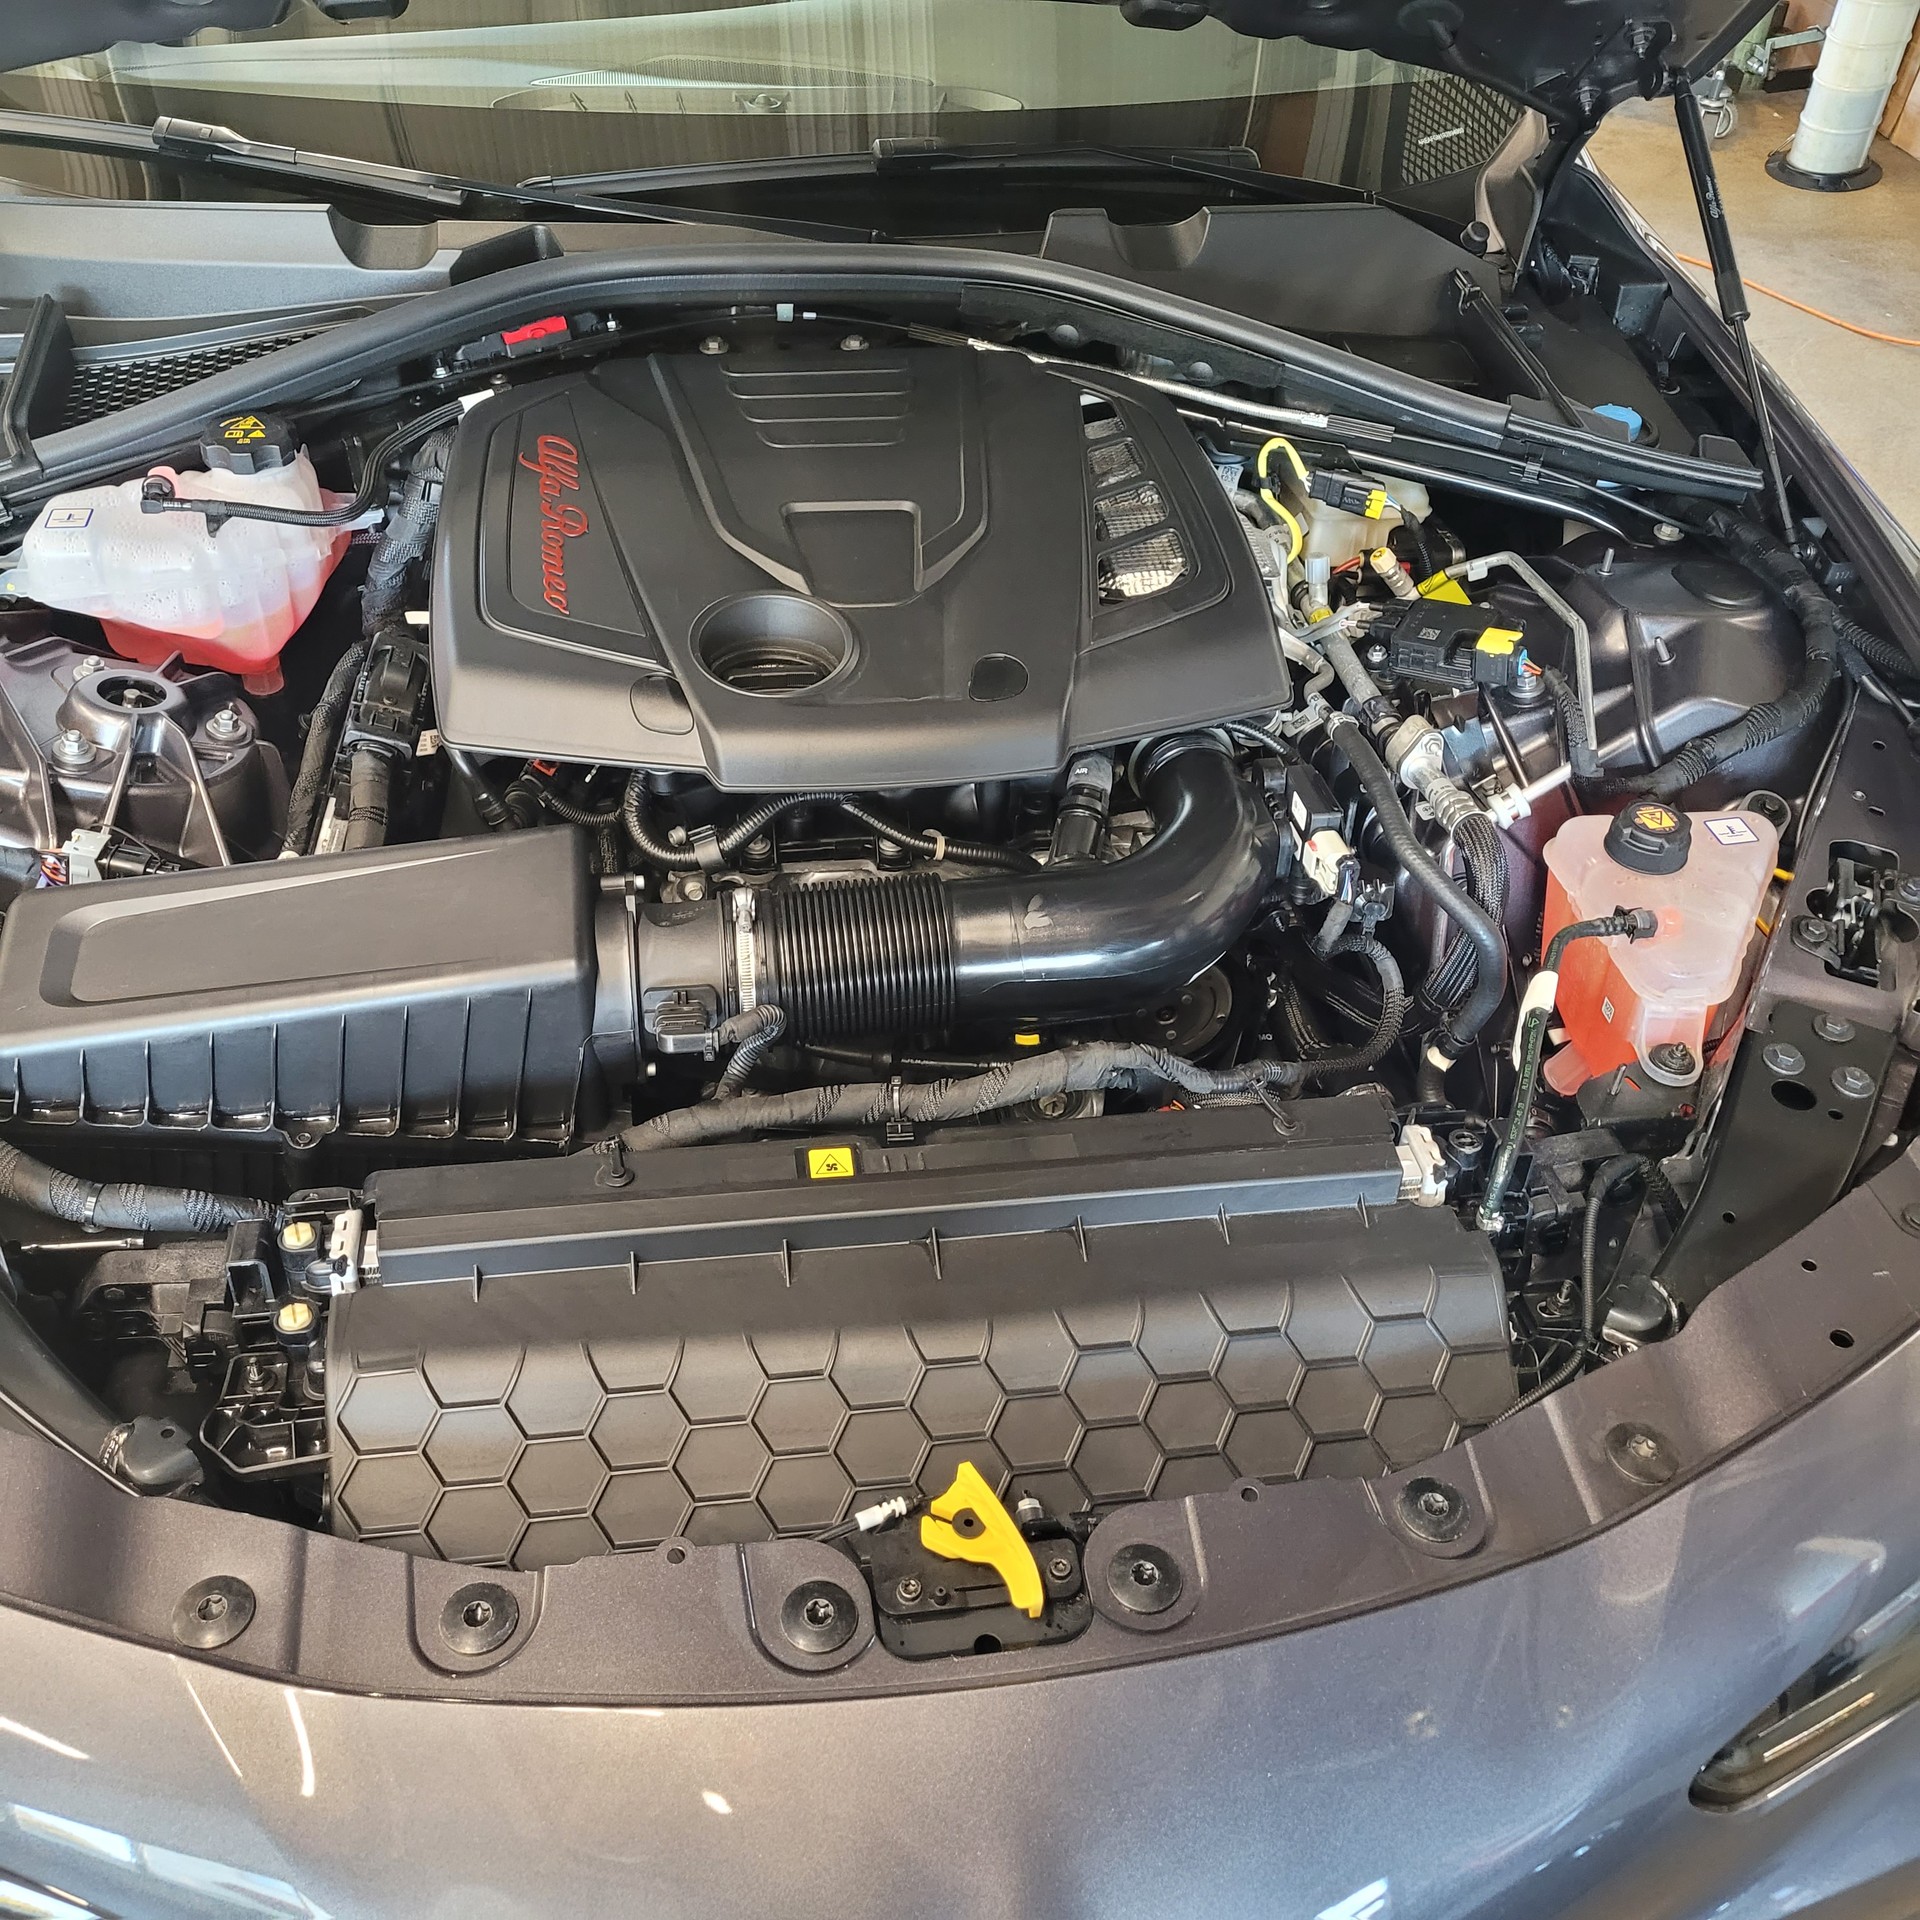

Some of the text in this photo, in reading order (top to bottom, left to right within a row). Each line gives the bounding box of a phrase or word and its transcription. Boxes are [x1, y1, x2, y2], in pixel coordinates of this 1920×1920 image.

[519, 434, 588, 614] Alfa Romeo
[1074, 767, 1089, 775] AIR
